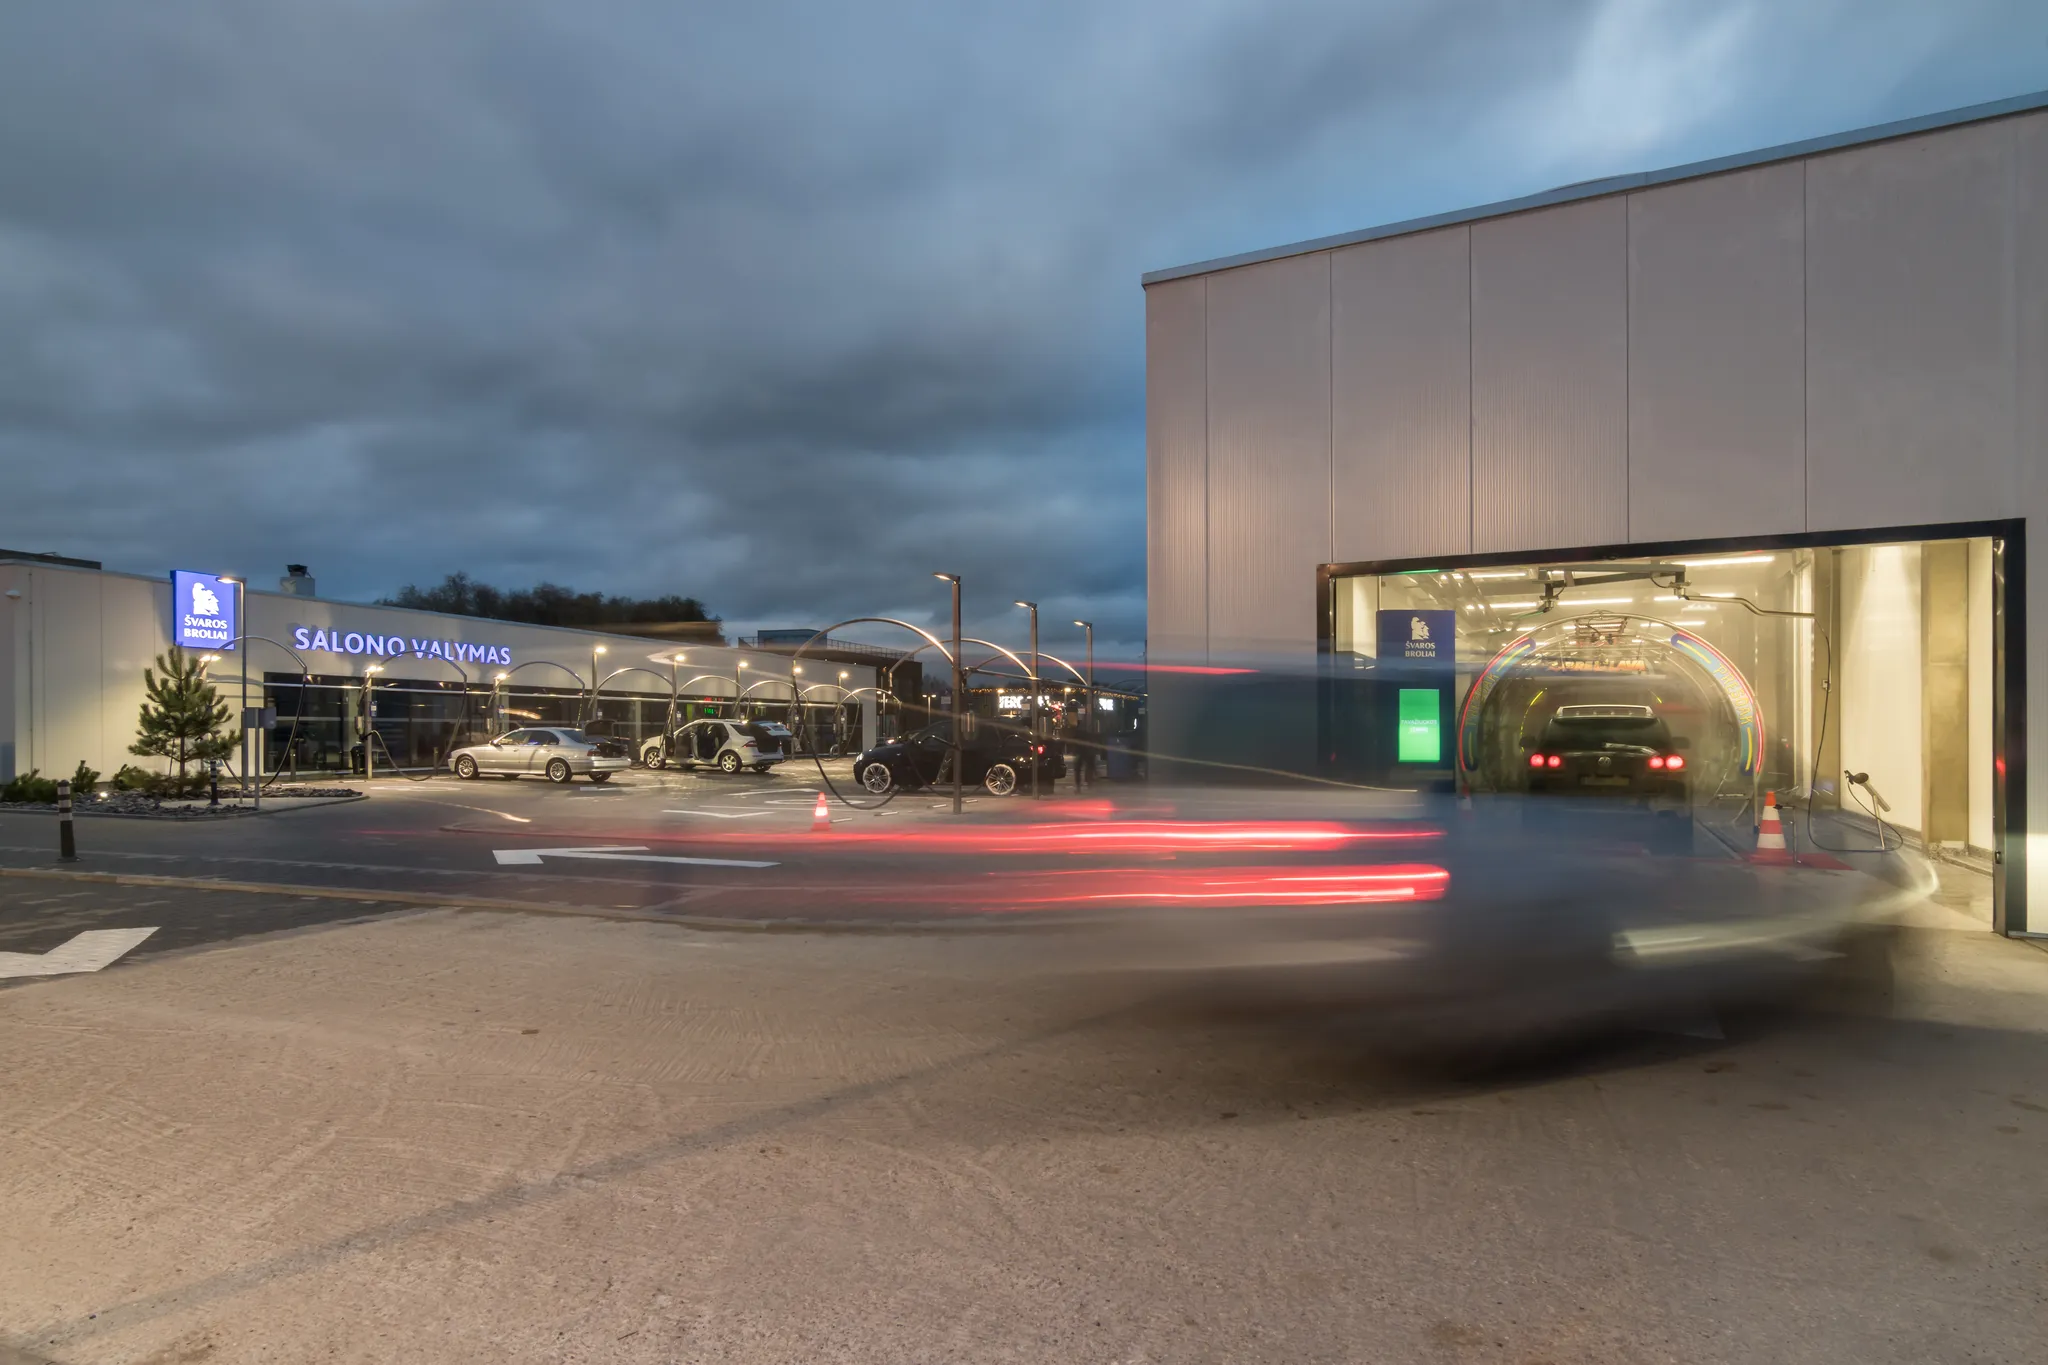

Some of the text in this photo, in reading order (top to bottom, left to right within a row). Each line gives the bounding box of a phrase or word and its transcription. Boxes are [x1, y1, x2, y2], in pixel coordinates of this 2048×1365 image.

[184, 614, 228, 629] ŠVAROS
[184, 628, 228, 640] BROLIAI
[295, 628, 512, 666] SALONO VALYMAS
[1405, 641, 1436, 650] ŠVAROS
[1405, 650, 1436, 658] BROLIAI
[1714, 663, 1753, 725] PRESOAK
